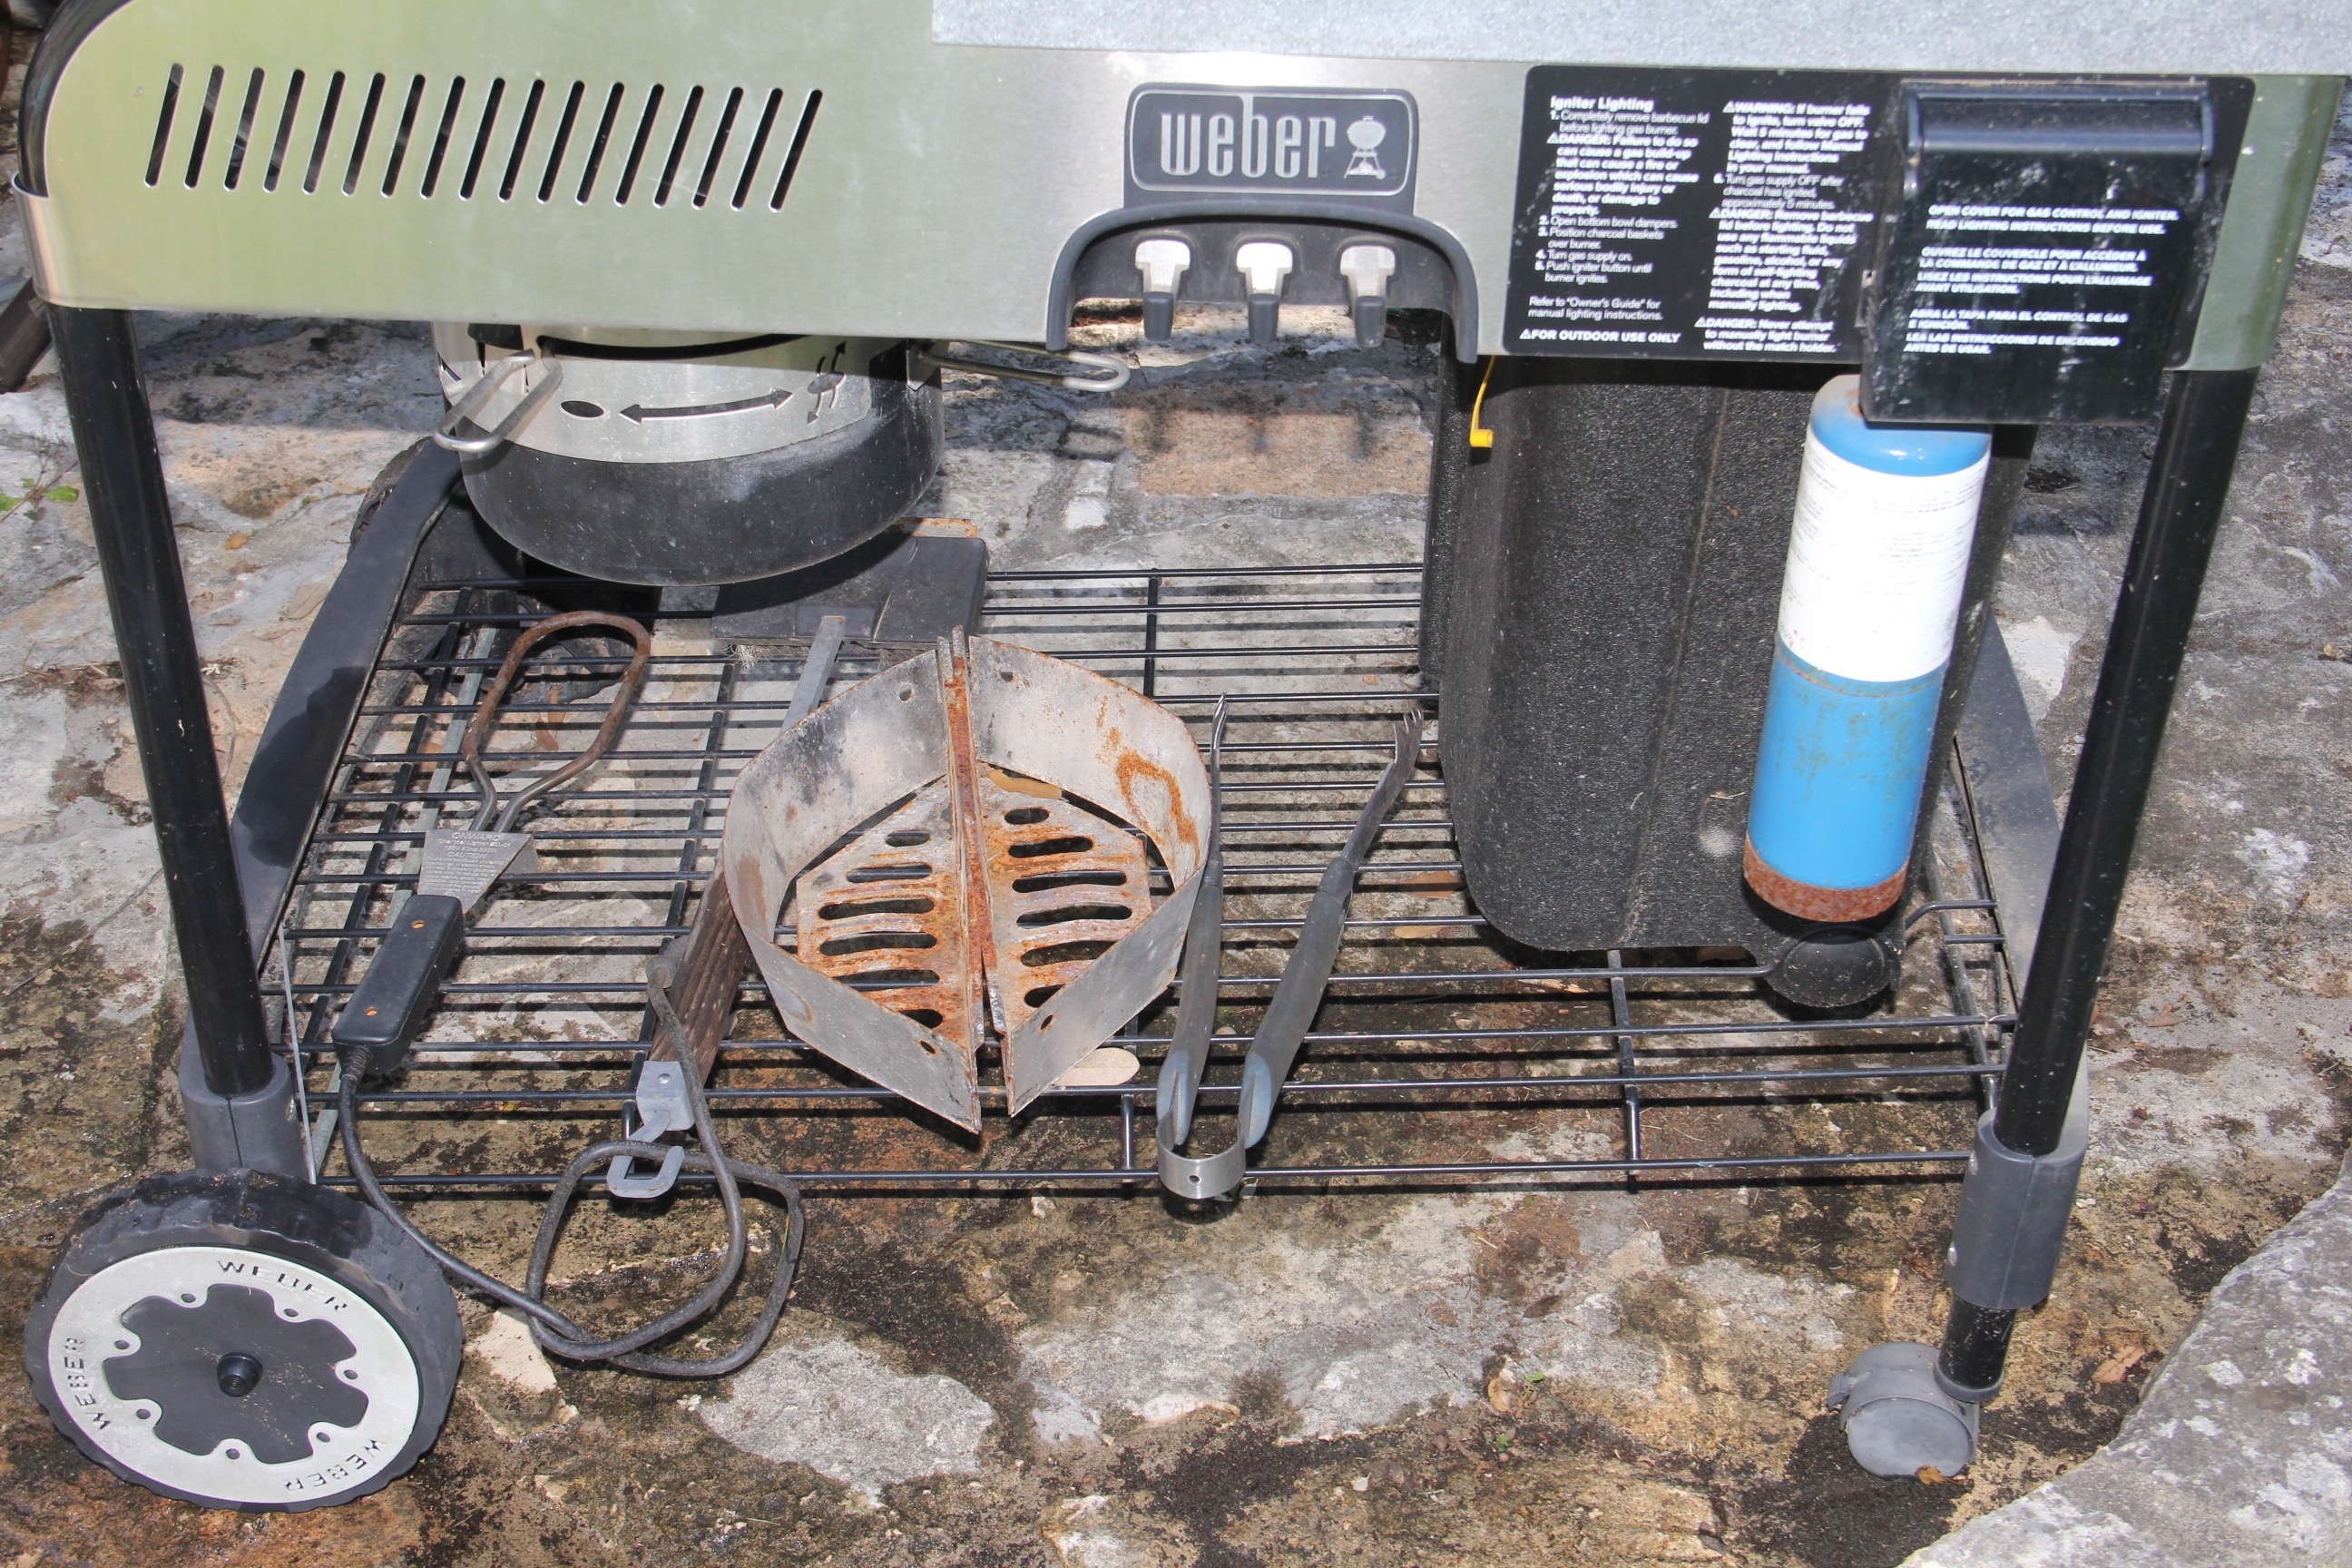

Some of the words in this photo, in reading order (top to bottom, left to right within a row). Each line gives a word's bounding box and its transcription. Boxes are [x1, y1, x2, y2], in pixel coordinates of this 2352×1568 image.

[1550, 96, 1596, 111] Igniter
[1597, 97, 1654, 113] Lighting
[1161, 96, 1337, 178] weber
[1530, 329, 1557, 340] FOR
[1558, 330, 1619, 341] OUTDOOR
[1620, 332, 1646, 342] USE
[1647, 333, 1681, 343] ONLY
[447, 851, 487, 859] CAUTION
[218, 1260, 348, 1311] WEBER
[64, 1338, 111, 1430] WEBER
[285, 1438, 387, 1490] WEBER
